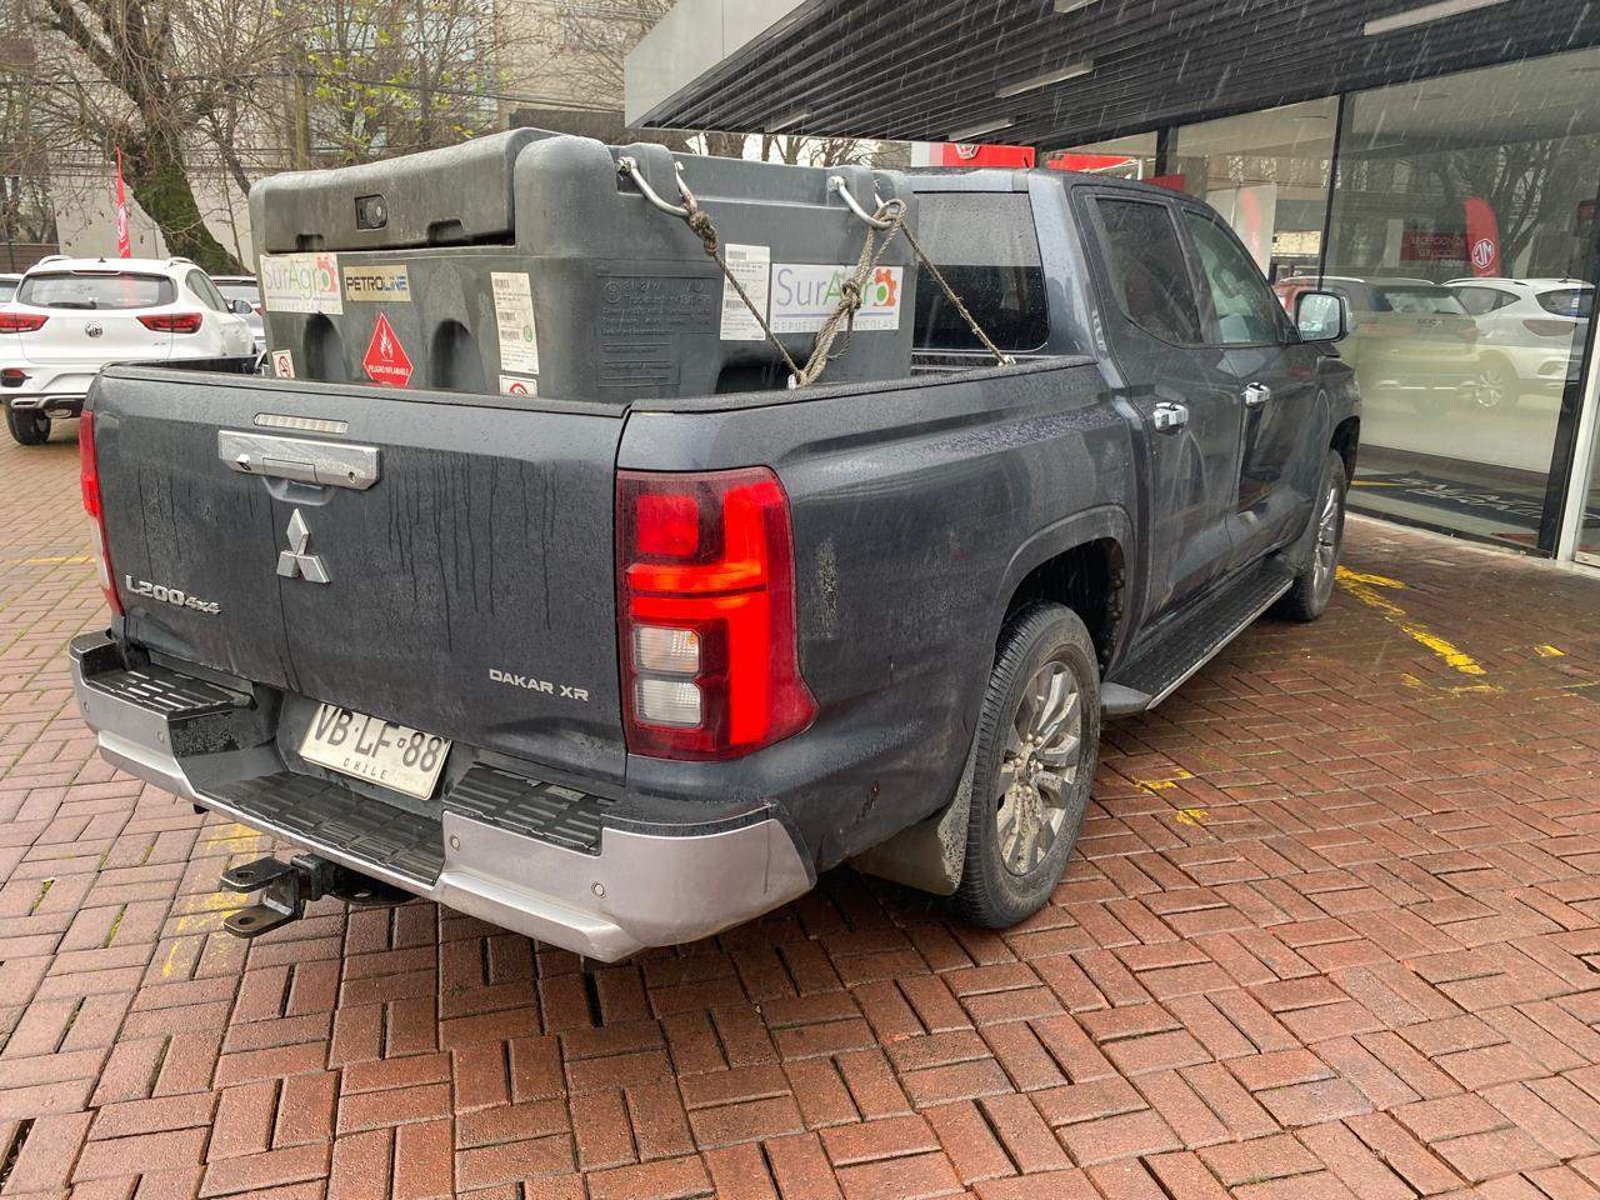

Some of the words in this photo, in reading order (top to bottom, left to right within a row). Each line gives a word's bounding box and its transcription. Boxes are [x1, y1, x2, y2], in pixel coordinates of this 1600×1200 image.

[776, 267, 896, 307] SurAro
[489, 668, 554, 695] DAKAR
[559, 684, 589, 702] XR
[343, 757, 389, 780] CHILE
